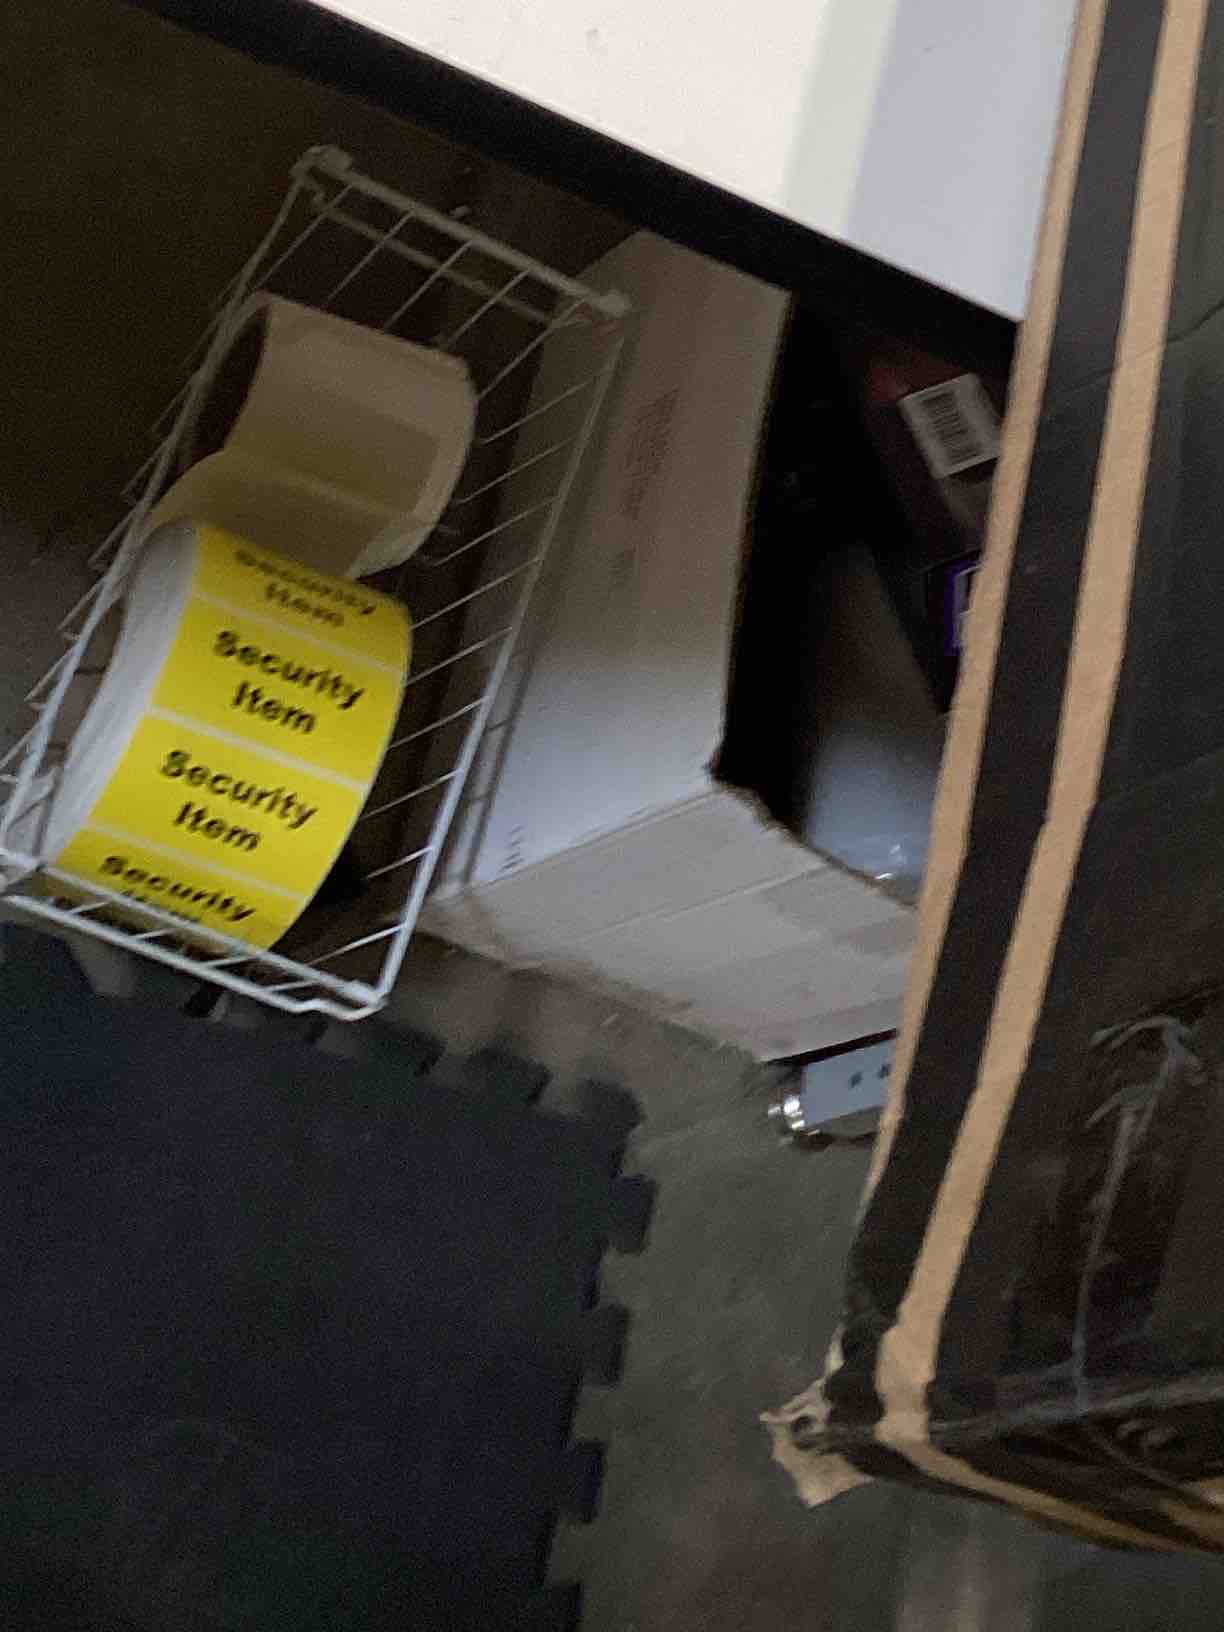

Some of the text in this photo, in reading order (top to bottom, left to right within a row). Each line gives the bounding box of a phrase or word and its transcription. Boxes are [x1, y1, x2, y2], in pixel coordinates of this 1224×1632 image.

[266, 582, 345, 628] Item
[214, 630, 364, 710] Security
[232, 680, 317, 734] Item
[160, 750, 318, 829] Security
[174, 800, 262, 852] Item
[101, 855, 256, 921] Security
